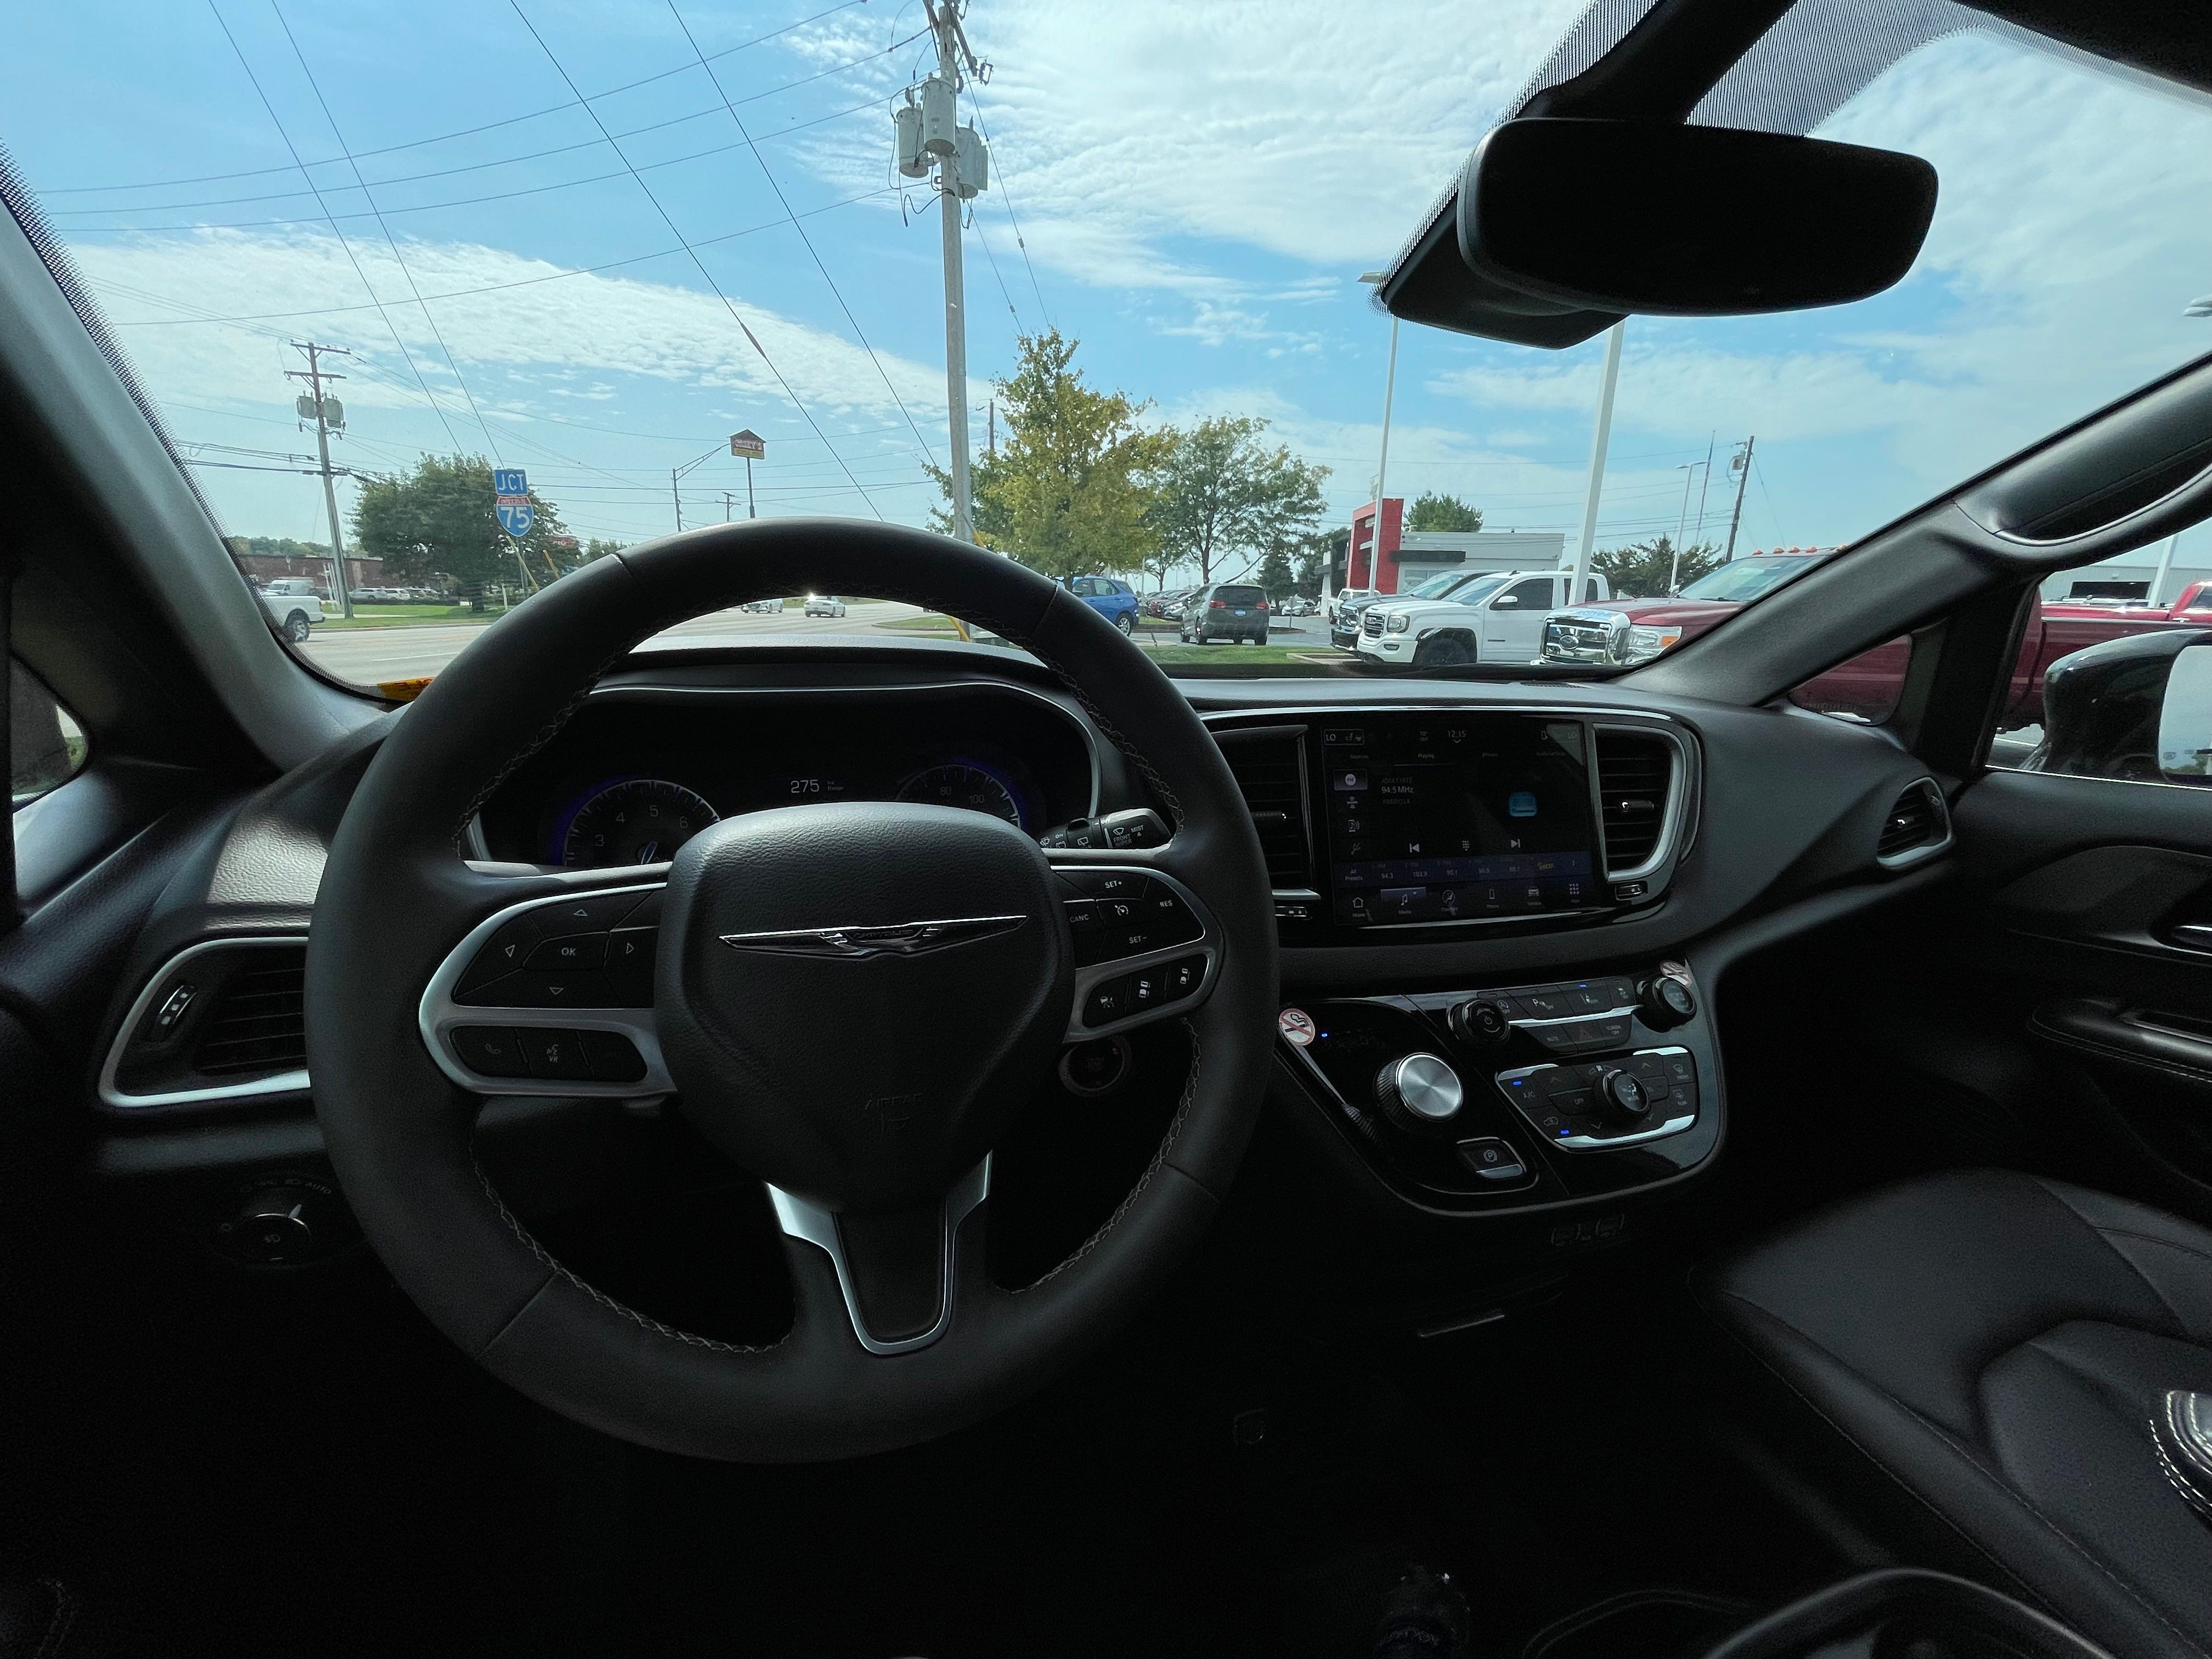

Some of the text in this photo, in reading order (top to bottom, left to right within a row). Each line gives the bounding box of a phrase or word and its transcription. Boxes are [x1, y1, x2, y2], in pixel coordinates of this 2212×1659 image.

[498, 473, 524, 491] JCT
[500, 506, 530, 529] 75
[790, 779, 820, 794] 275
[940, 786, 952, 796] 80
[969, 794, 985, 805] 100
[650, 804, 658, 817] 5
[616, 811, 625, 823] 4
[679, 816, 689, 829] 6
[1131, 825, 1144, 833] MIST
[595, 834, 605, 847] 3
[1159, 899, 1173, 908] RES
[1069, 913, 1090, 923] CANC
[561, 947, 577, 956] OK
[1523, 1090, 1536, 1098] A/C
